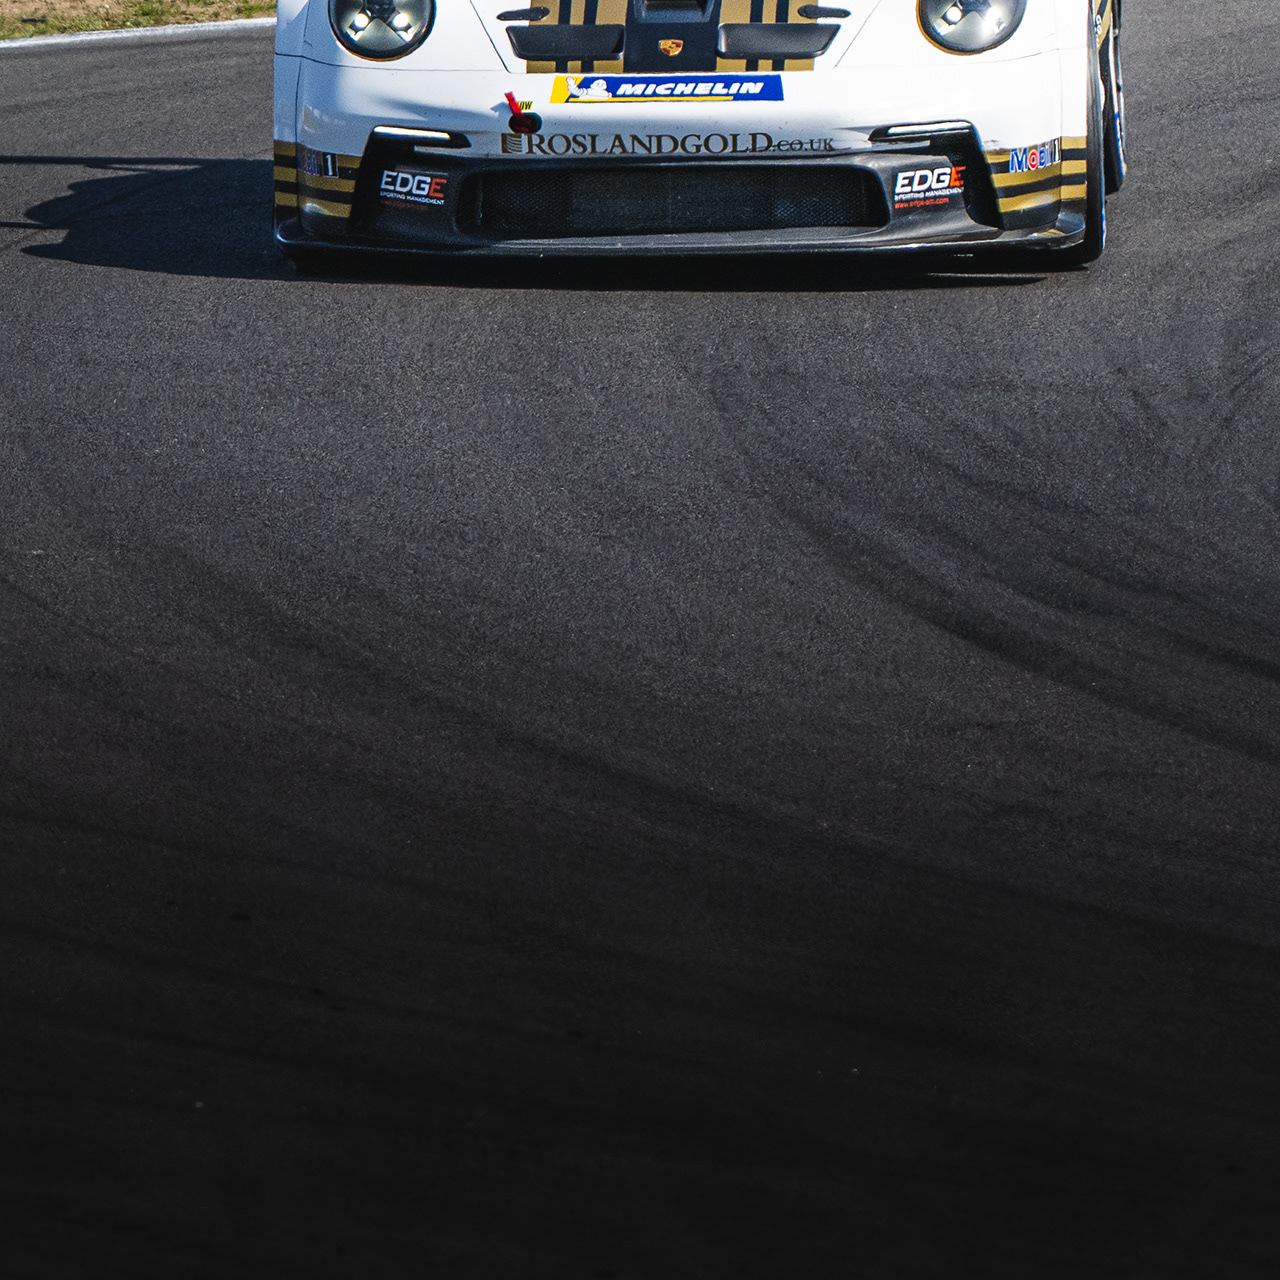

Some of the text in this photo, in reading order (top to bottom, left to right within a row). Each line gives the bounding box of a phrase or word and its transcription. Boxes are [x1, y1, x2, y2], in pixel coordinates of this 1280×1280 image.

[616, 81, 764, 96] MICHELIN
[1009, 145, 1051, 174] Mobil
[380, 170, 447, 198] EDGE
[895, 166, 966, 194] EDGE
[406, 195, 445, 205] MANAGEMENT
[925, 186, 965, 197] MANAGEMENT
